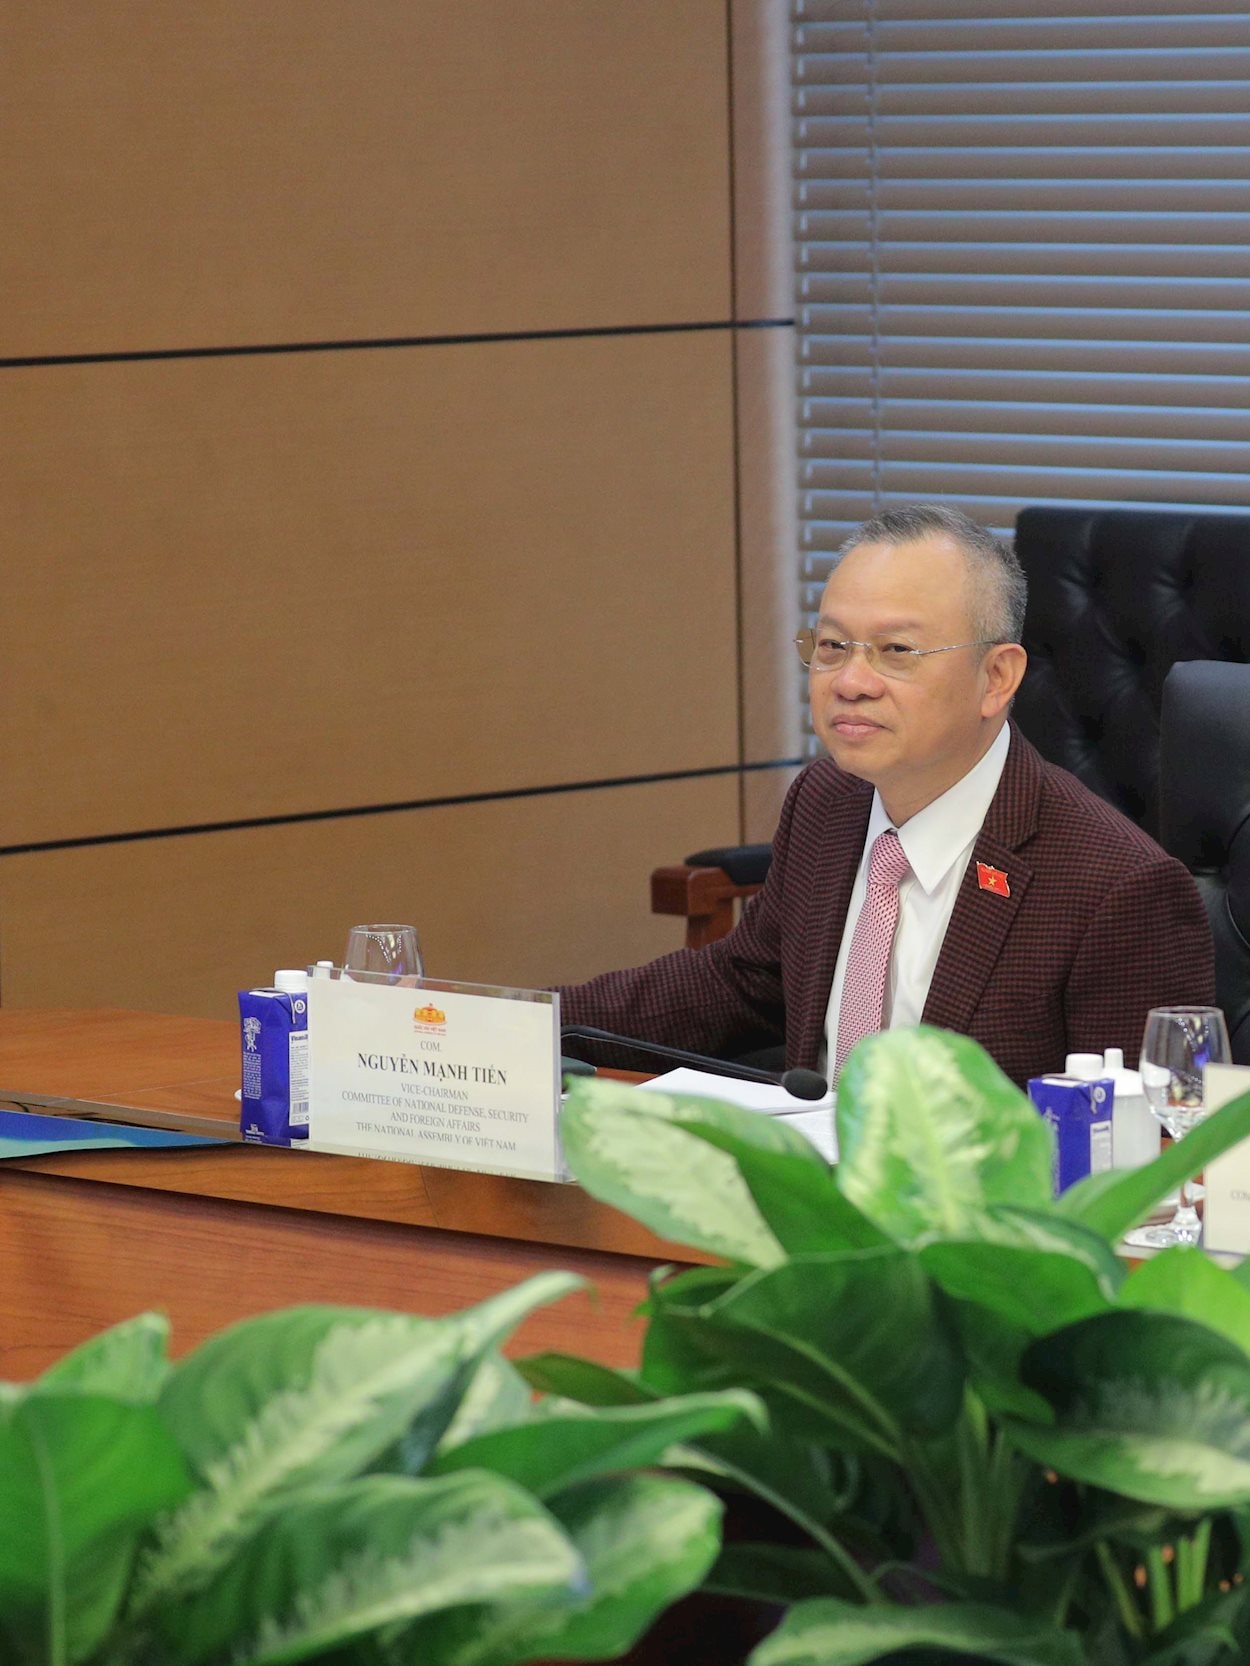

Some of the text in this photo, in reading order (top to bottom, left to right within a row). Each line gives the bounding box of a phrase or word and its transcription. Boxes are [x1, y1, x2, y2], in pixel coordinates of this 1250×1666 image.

[423, 1060, 468, 1082] MẠNH
[400, 1082, 469, 1100] VICE-CHAIRMAN
[341, 1090, 391, 1106] COMMITTEE
[392, 1096, 404, 1108] OF
[404, 1098, 447, 1113] NATIONAL
[487, 1108, 529, 1123] SECURITY
[391, 1111, 481, 1133] AND FOREIGN AFFAIRS
[495, 1139, 517, 1151] NAM
